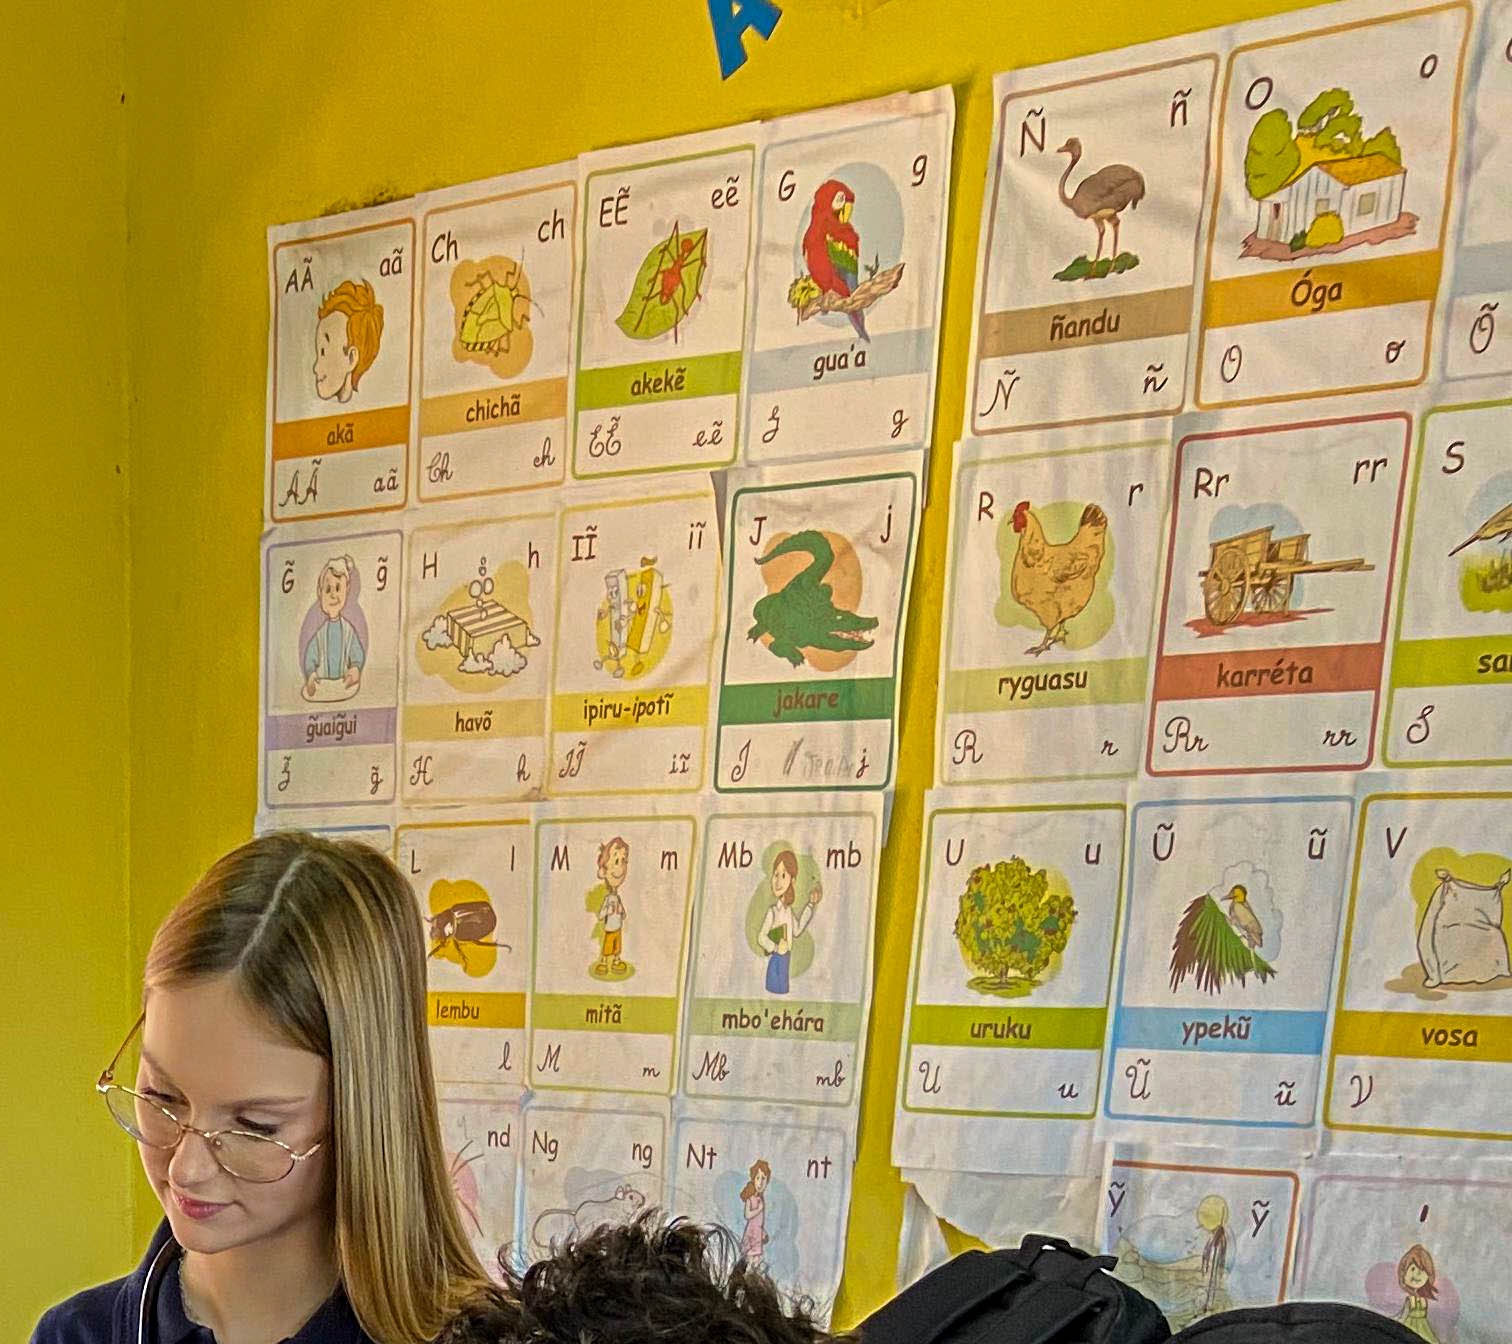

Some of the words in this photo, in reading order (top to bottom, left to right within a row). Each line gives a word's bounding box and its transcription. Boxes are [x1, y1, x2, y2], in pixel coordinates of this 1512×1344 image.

[1245, 77, 1273, 110] O
[1420, 55, 1437, 78] o
[1020, 107, 1045, 157] Ñ
[1171, 88, 1192, 127] ñ
[779, 170, 796, 201] G
[912, 155, 927, 186] g
[432, 231, 458, 263] Ch
[538, 209, 564, 242] ch
[285, 257, 313, 293] AÃ
[380, 248, 403, 276] aã
[1291, 269, 1342, 313] Óga
[1050, 308, 1120, 341] ñandu
[813, 344, 866, 380] gua'a
[1143, 364, 1168, 393] ñ
[631, 368, 686, 396] akekẽ
[466, 394, 520, 422] chichã
[891, 410, 908, 438] g
[327, 423, 354, 445] akã
[427, 452, 453, 483] Ch
[534, 437, 555, 467] ch
[1442, 441, 1464, 474] S
[1194, 468, 1229, 499] Rr
[1354, 458, 1387, 484] rr
[978, 492, 993, 521] R
[1129, 484, 1143, 506] r
[750, 516, 767, 545] J
[880, 505, 892, 543] j
[423, 552, 437, 579] H
[529, 542, 539, 568] h
[999, 671, 1087, 700] ryguasu
[1217, 658, 1313, 688] karréta
[584, 693, 674, 726] ipiru-ipotĩ
[773, 686, 843, 721] jakare
[456, 710, 492, 732] havõ
[1163, 717, 1208, 753] Rr
[1323, 730, 1357, 746] rr
[1407, 705, 1434, 744] S
[731, 739, 751, 782] J
[856, 748, 869, 779] j
[953, 729, 983, 764] R
[1101, 740, 1118, 756] r
[410, 756, 433, 785] H
[517, 754, 530, 782] h
[551, 845, 569, 870] M
[661, 851, 677, 870] m
[718, 841, 752, 868] Mb
[827, 841, 861, 869] mb
[946, 839, 964, 866] U
[1085, 844, 1101, 865] u
[1153, 823, 1174, 861] Ũ
[1309, 829, 1327, 859] ũ
[1387, 827, 1407, 858] V
[411, 850, 421, 874] L
[437, 1000, 479, 1019] lembu
[586, 1004, 622, 1023] mitã
[722, 1008, 824, 1032] mbo'ehára
[971, 1016, 1031, 1040] uruku
[1183, 1015, 1251, 1045] ypekũ
[1422, 1028, 1478, 1047] vosa
[537, 1044, 561, 1072] M
[643, 1068, 660, 1077] m
[692, 1051, 729, 1081] Mb
[816, 1060, 845, 1087] mb
[919, 1061, 941, 1094] U
[1058, 1084, 1078, 1098] u
[1126, 1058, 1150, 1100] Ũ
[1275, 1081, 1296, 1105] ũ
[488, 1124, 510, 1147] nd
[533, 1130, 558, 1162] Ng
[632, 1143, 652, 1169] ng
[687, 1144, 717, 1169] Nt
[807, 1156, 832, 1179] nt
